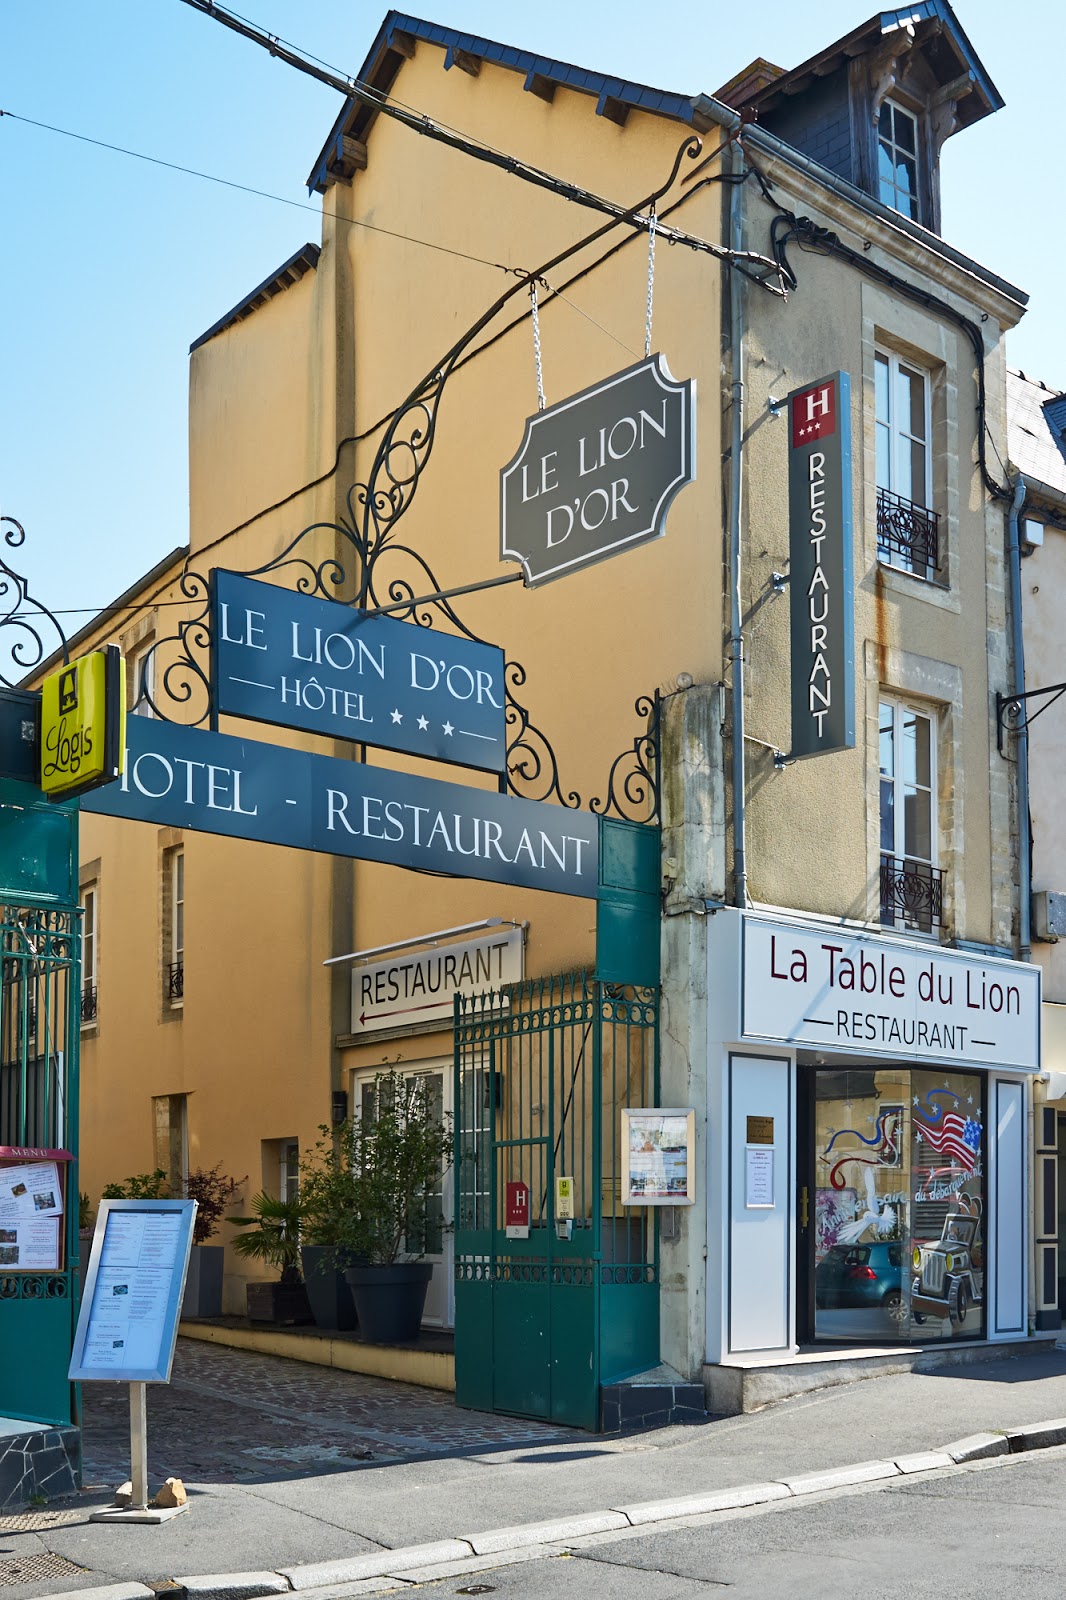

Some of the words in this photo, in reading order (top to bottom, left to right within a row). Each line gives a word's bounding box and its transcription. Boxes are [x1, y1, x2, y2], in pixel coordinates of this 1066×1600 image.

[804, 387, 831, 423] H
[521, 451, 559, 503] LE
[578, 398, 668, 477] LION
[546, 478, 640, 549] D'OR
[807, 451, 831, 738] RESTAURANT
[219, 602, 268, 651] LE
[290, 621, 386, 680] LION
[409, 652, 503, 709] D'OR
[280, 675, 374, 723] HÔTEL
[43, 717, 93, 777] Logis
[325, 788, 590, 876] RESTAURANT
[360, 941, 509, 1007] RESTAURANT
[770, 935, 808, 983] La
[821, 944, 906, 998] Table
[917, 962, 953, 1005] du
[966, 970, 1020, 1016] Lion
[836, 1010, 968, 1051] RESTAURANT
[11, 1148, 48, 1157] MENU
[515, 1190, 526, 1207] H
[914, 1183, 927, 1203] du
